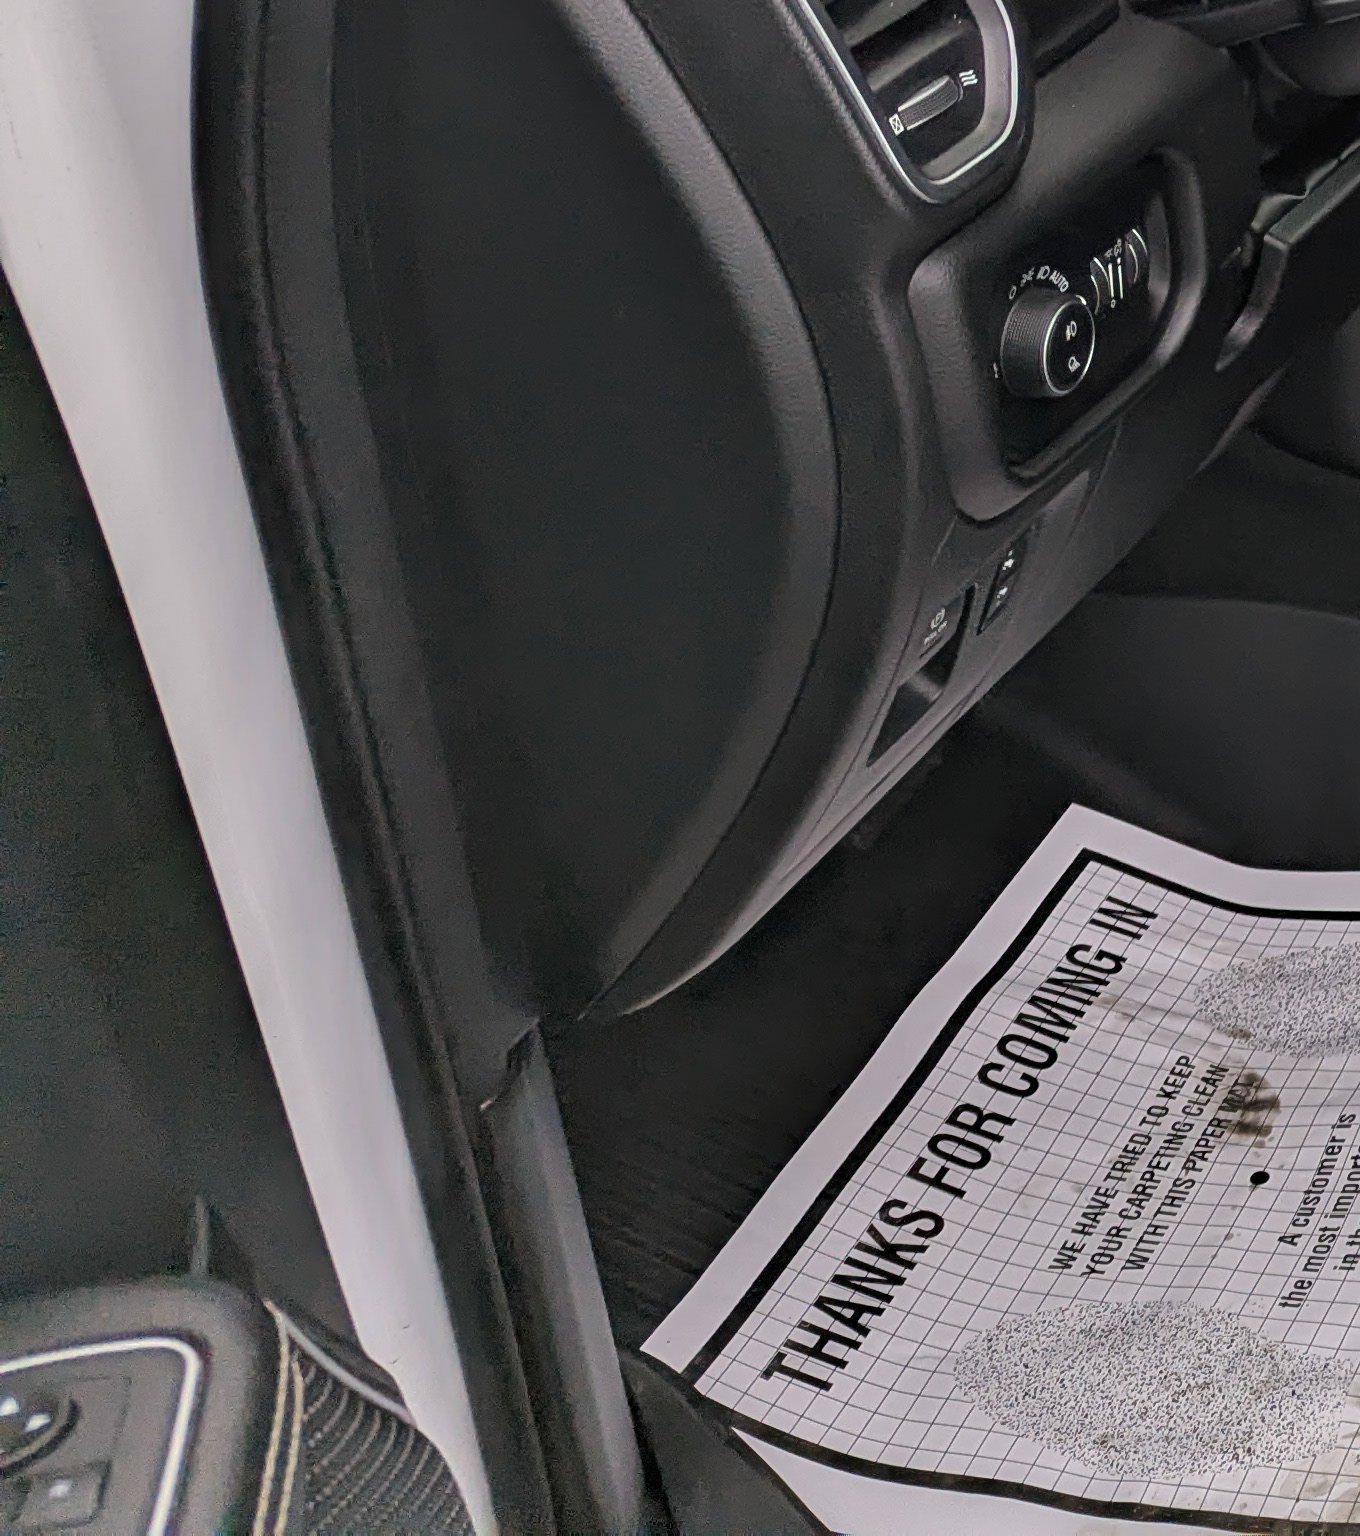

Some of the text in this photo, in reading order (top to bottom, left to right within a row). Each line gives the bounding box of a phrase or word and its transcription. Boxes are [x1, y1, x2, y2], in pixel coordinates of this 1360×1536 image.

[1049, 269, 1069, 292] AUTO
[760, 896, 1159, 1392] THANKS FOR COMING IN
[1048, 1055, 1196, 1270] WE HAVE TRIED TO KEEP
[1080, 1064, 1229, 1277] YOUR CARPETING CLEAN
[1121, 1080, 1254, 1270] WITH THIS PAPER MAT
[1278, 1114, 1356, 1246] A customer is
[1279, 1279, 1312, 1308] the
[1303, 1226, 1340, 1272] most
[1334, 1253, 1360, 1270] in
